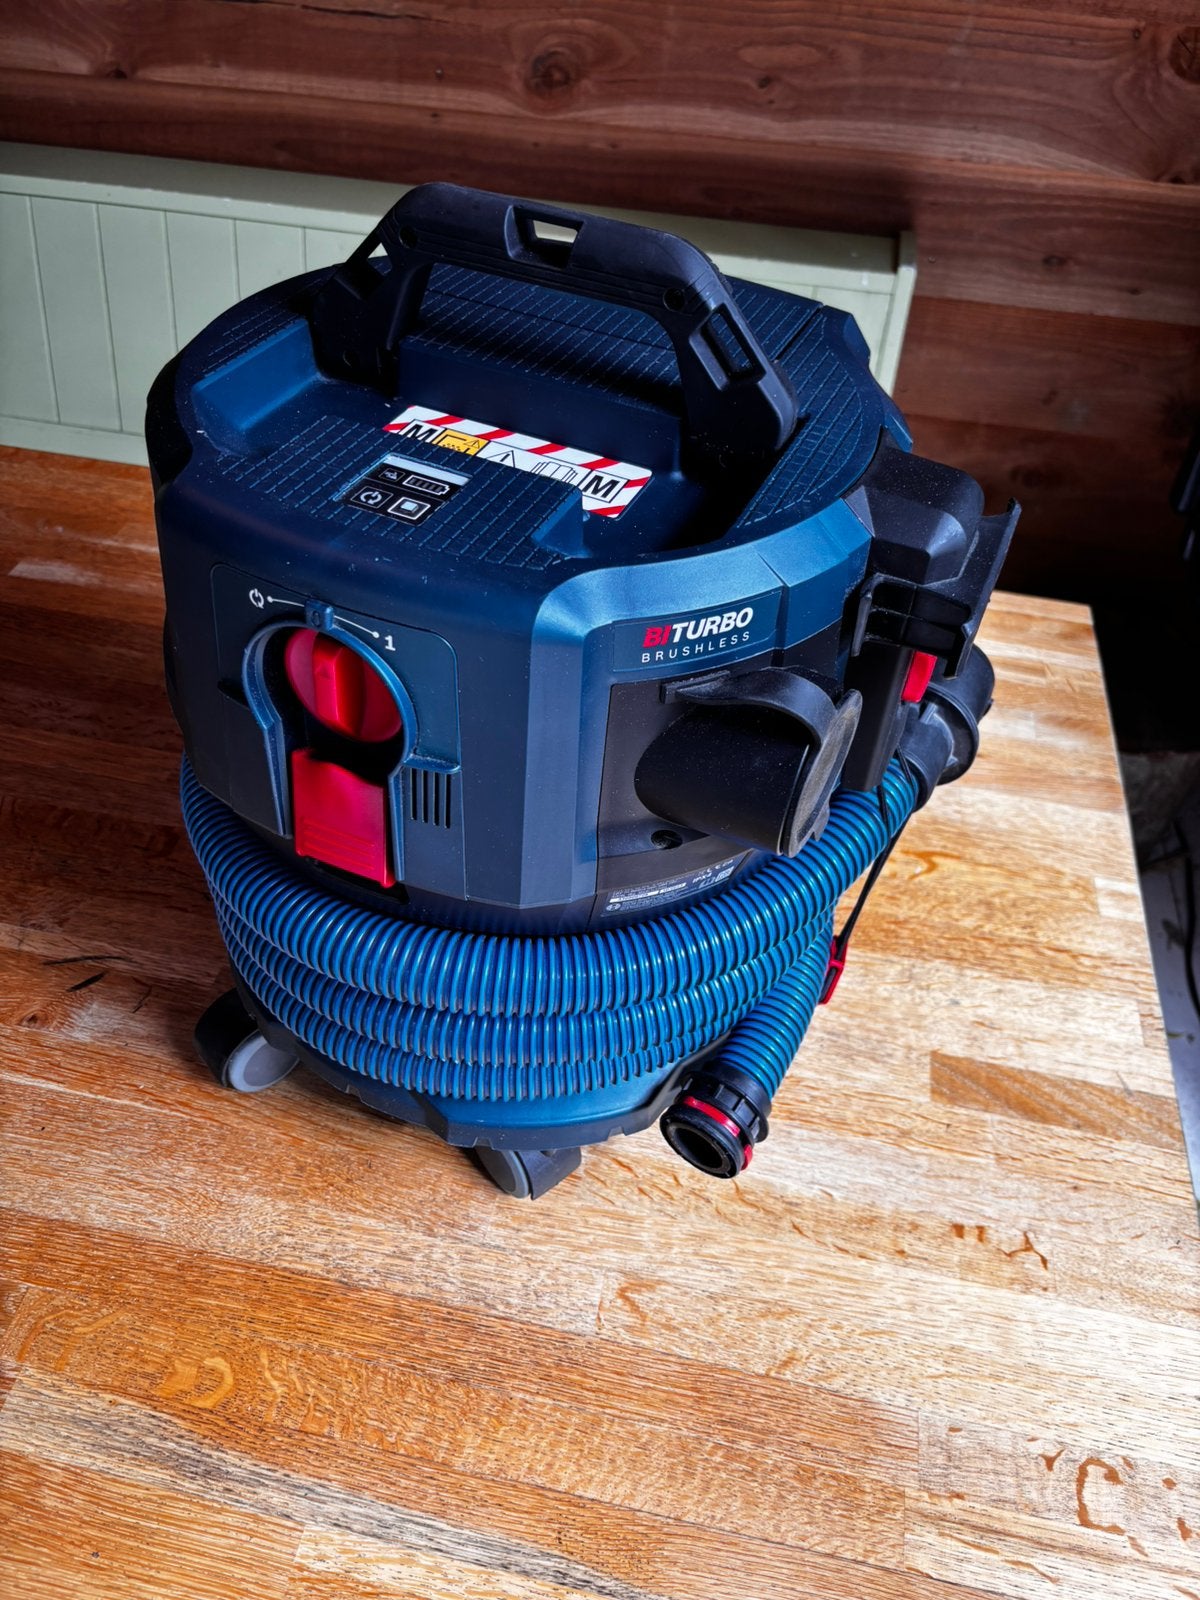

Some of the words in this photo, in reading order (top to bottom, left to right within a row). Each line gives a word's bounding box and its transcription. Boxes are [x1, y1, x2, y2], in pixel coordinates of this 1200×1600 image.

[405, 424, 438, 442] M
[585, 475, 619, 499] M
[643, 607, 754, 648] BITURBO
[384, 635, 396, 651] 1
[641, 631, 750, 663] BRUSHLESS
